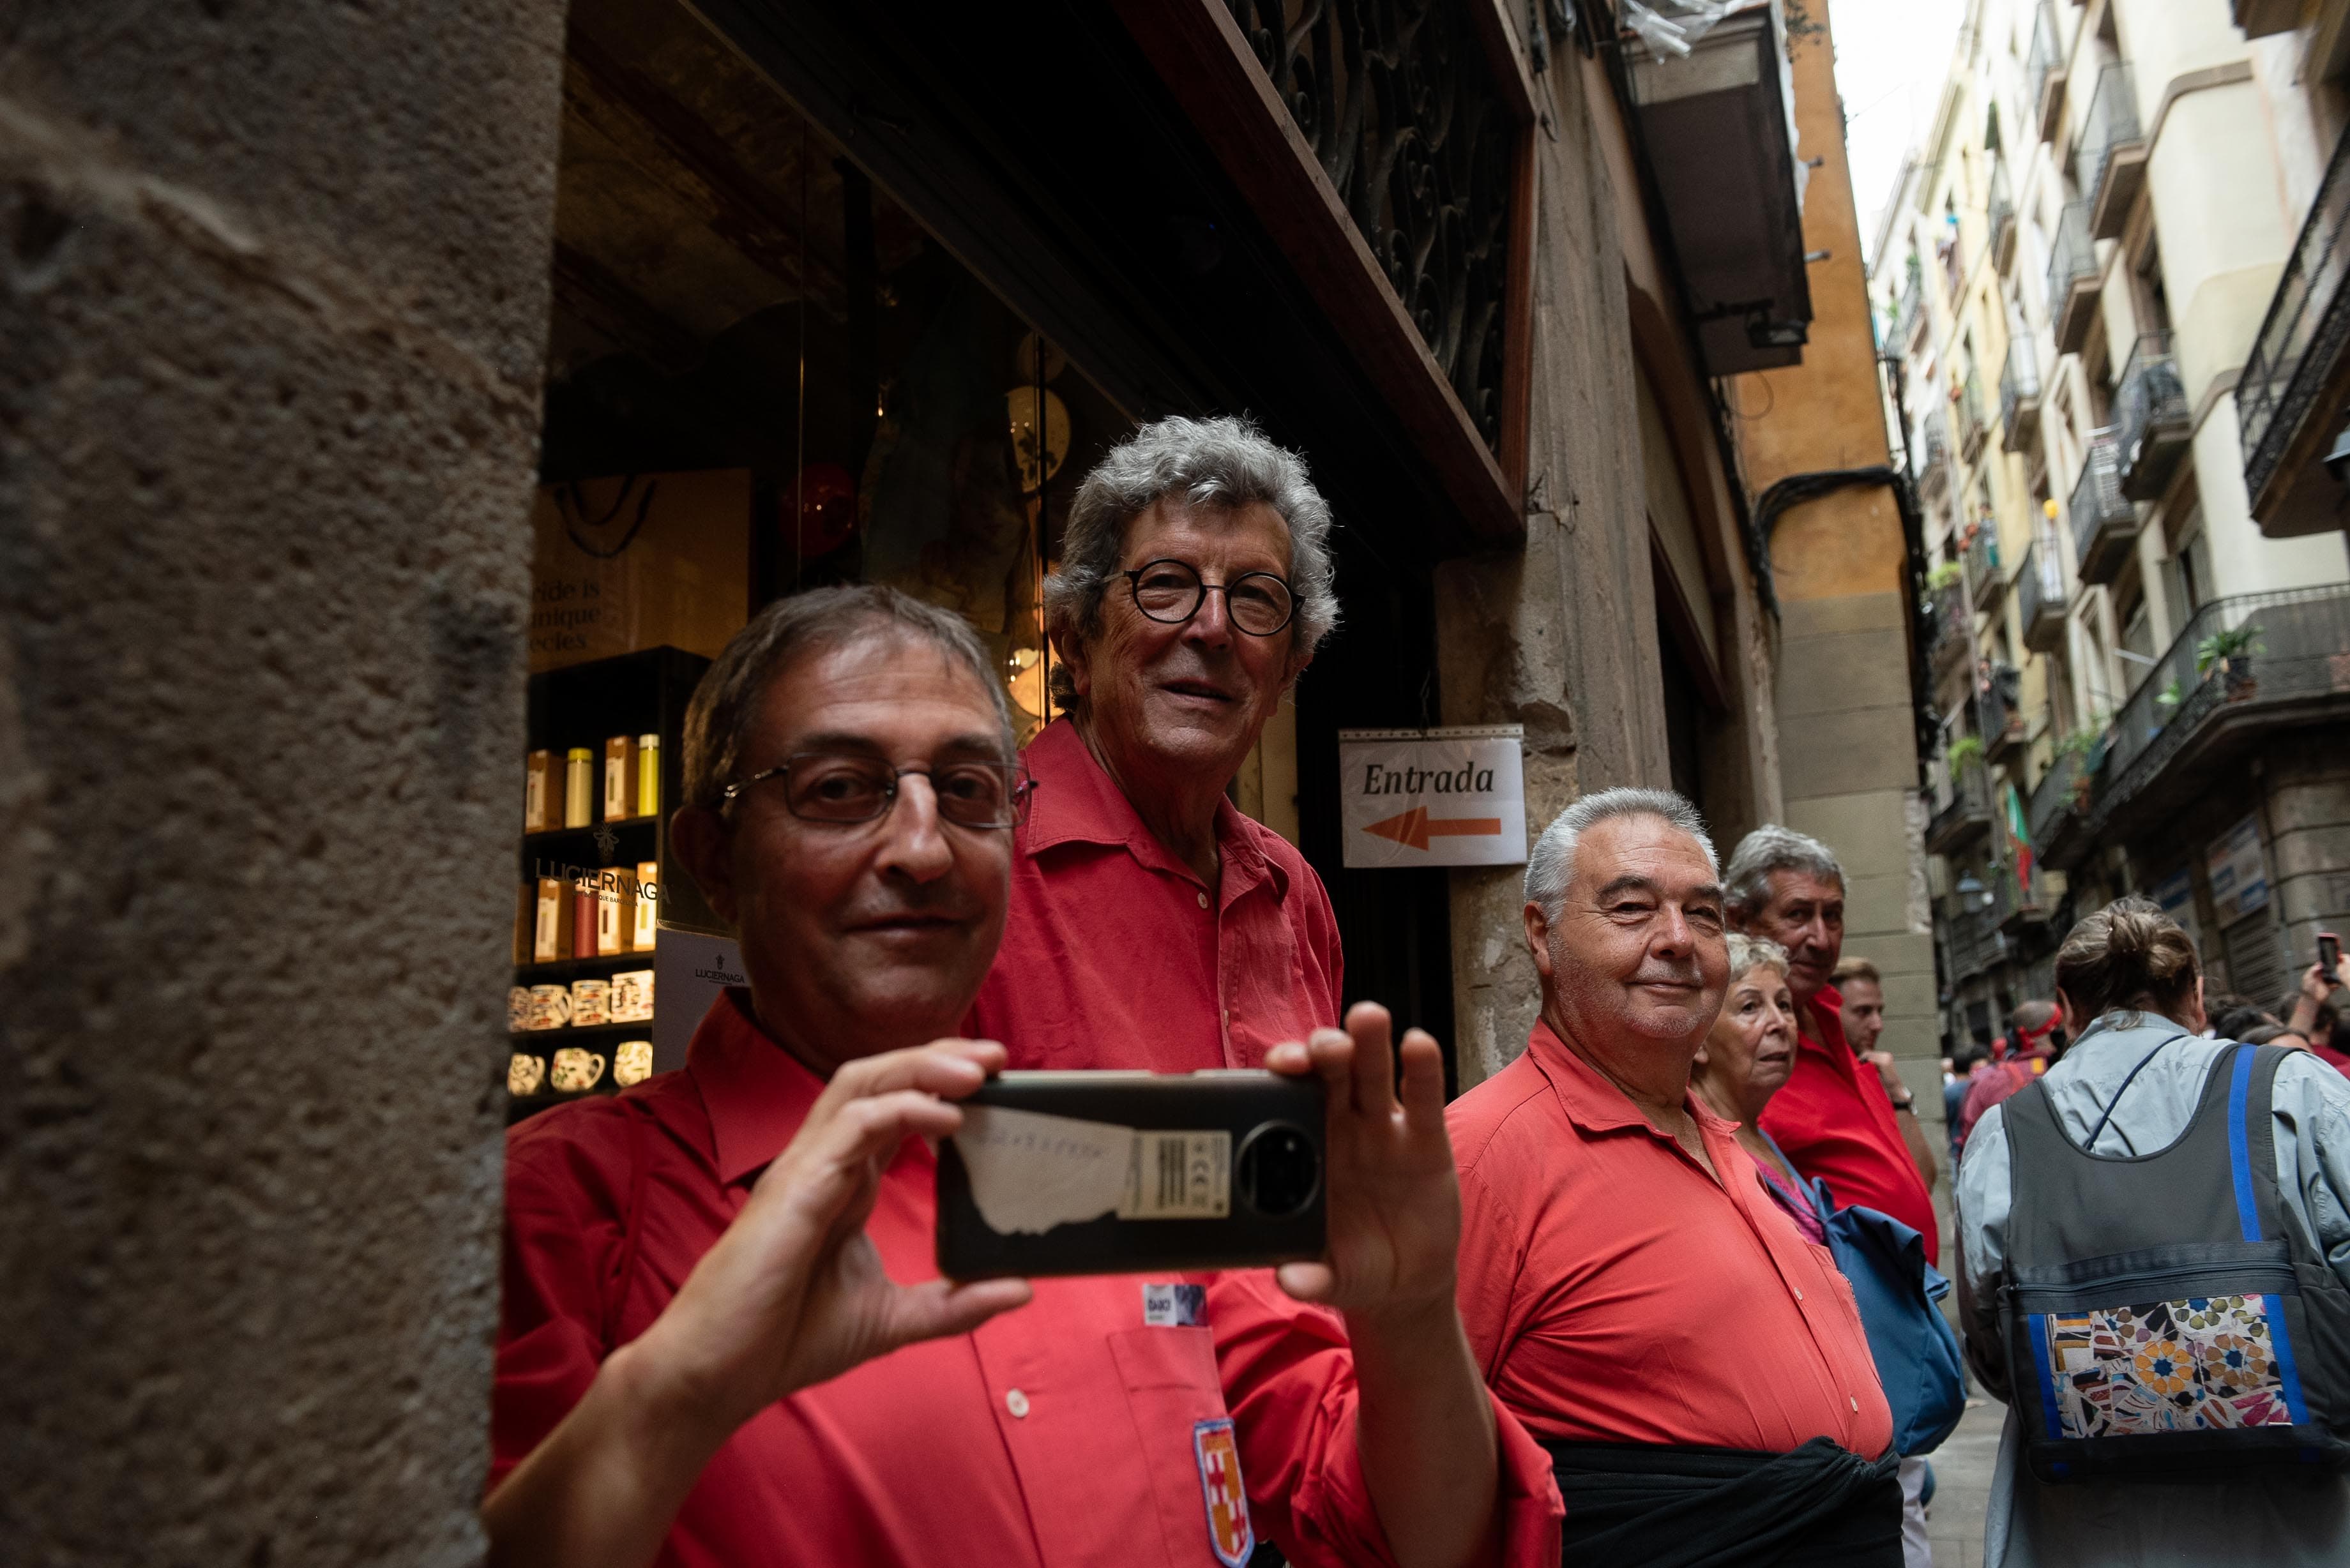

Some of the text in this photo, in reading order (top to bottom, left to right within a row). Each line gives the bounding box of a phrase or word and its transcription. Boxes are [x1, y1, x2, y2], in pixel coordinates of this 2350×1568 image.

[583, 578, 600, 598] is
[1362, 761, 1494, 795] Entrada
[535, 857, 672, 905] LUCIERNAGA
[695, 969, 745, 983] LUCIERNAGA
